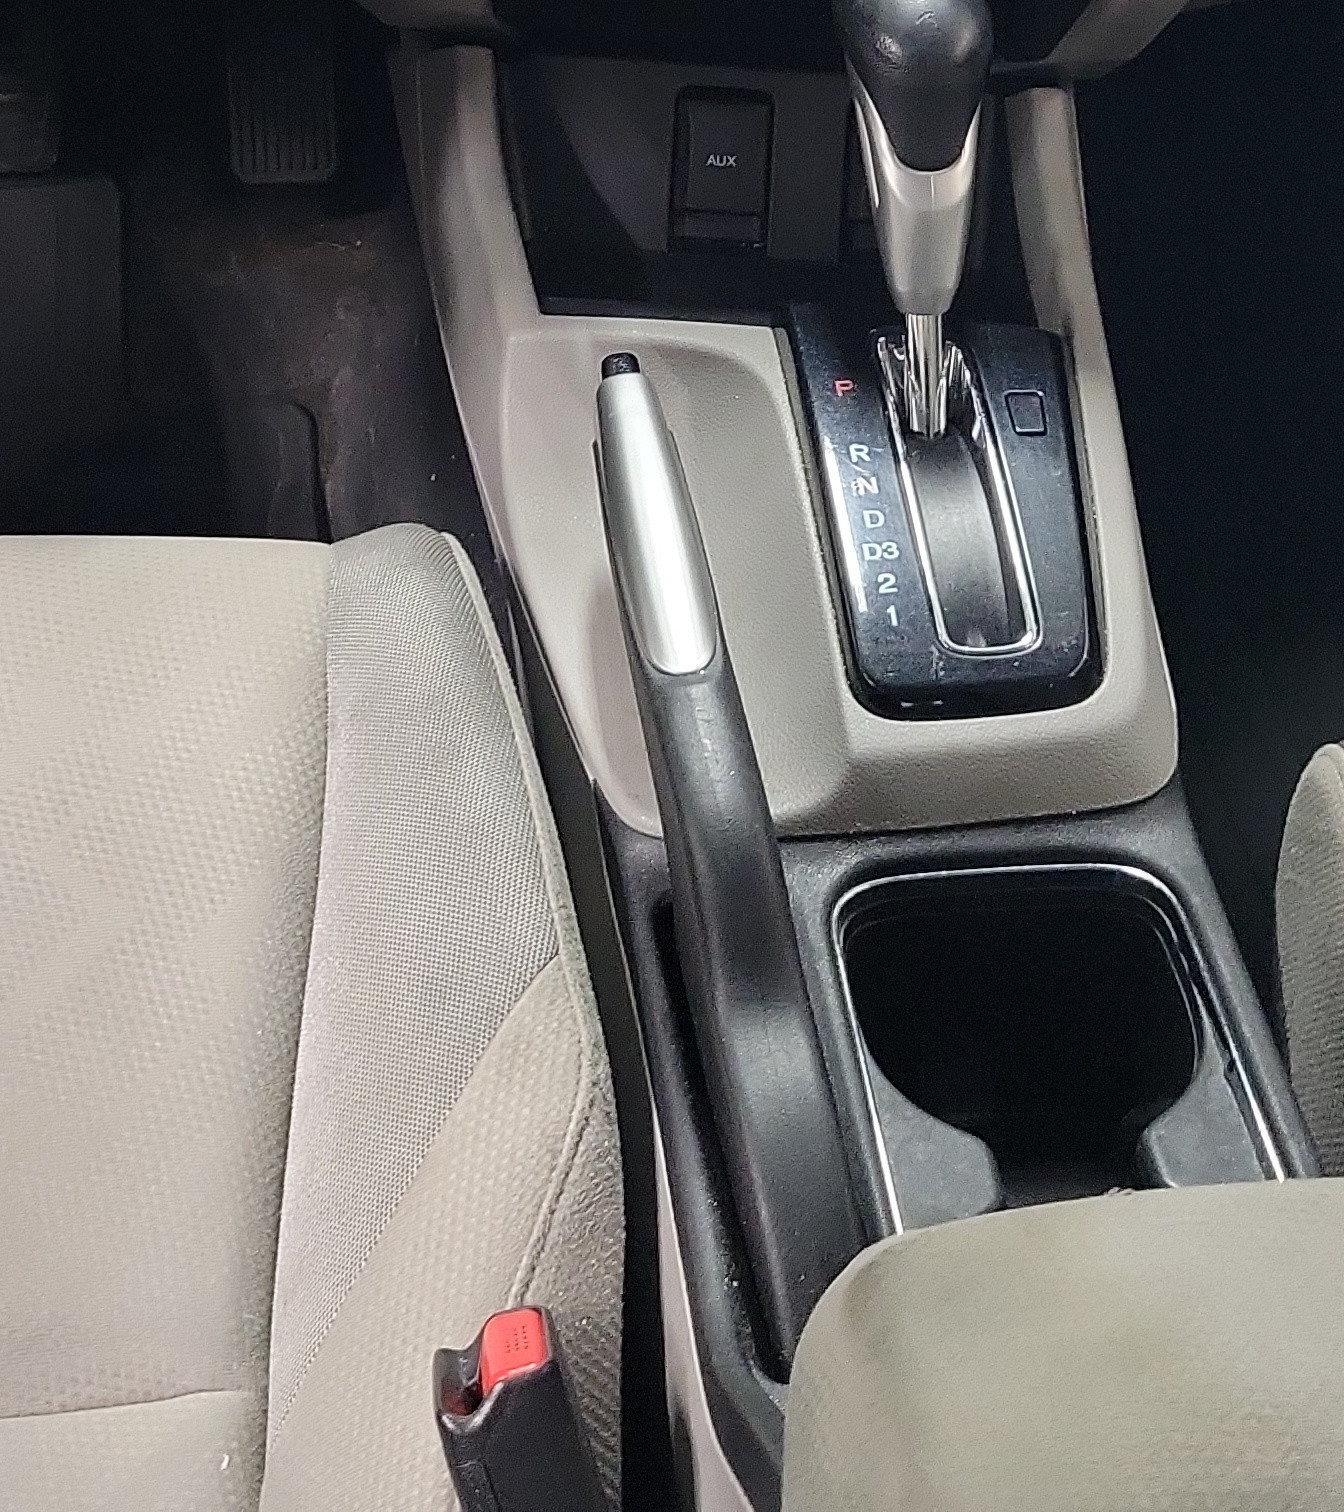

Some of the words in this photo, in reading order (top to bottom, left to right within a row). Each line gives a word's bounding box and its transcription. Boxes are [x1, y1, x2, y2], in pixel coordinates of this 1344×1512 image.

[706, 154, 737, 167] AUX
[833, 380, 854, 397] P
[849, 444, 870, 463] R
[859, 476, 879, 495] N
[863, 510, 885, 529] D
[862, 542, 900, 561] D3
[877, 573, 897, 594] 2
[886, 604, 898, 627] 1
